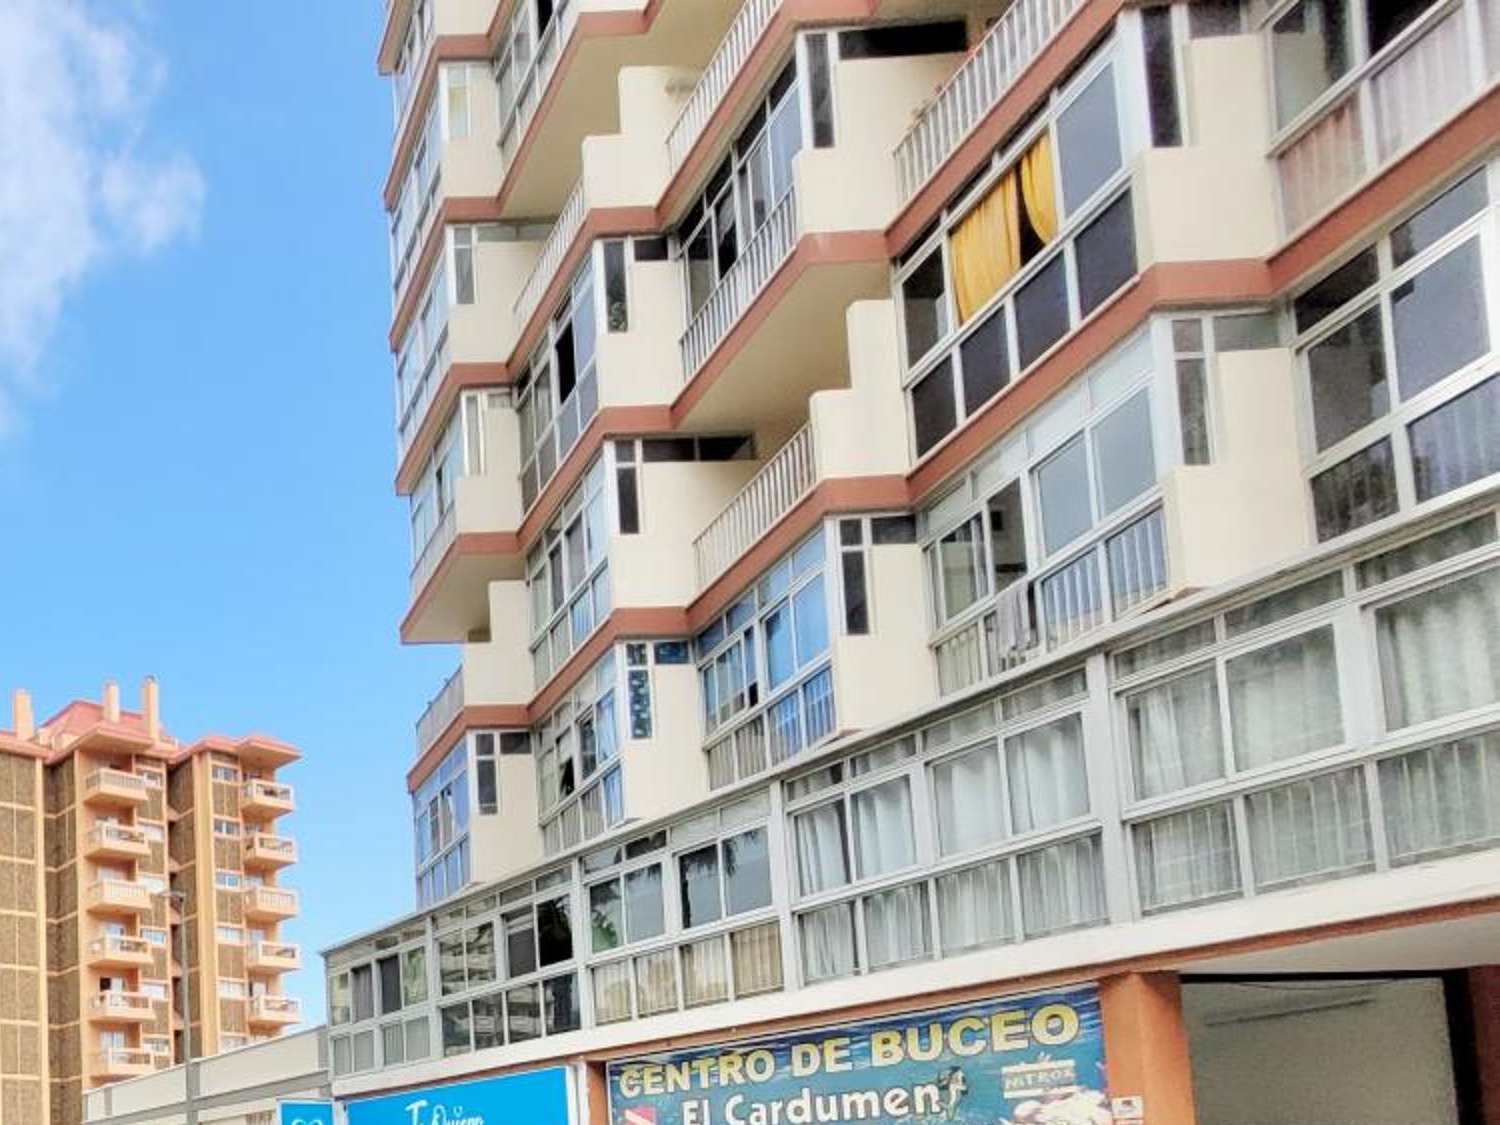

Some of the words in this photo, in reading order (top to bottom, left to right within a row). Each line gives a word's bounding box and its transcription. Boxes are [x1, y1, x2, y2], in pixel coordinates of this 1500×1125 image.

[619, 1048, 776, 1099] CENTRO
[792, 1036, 853, 1077] DE
[871, 1003, 1080, 1067] BUCEO
